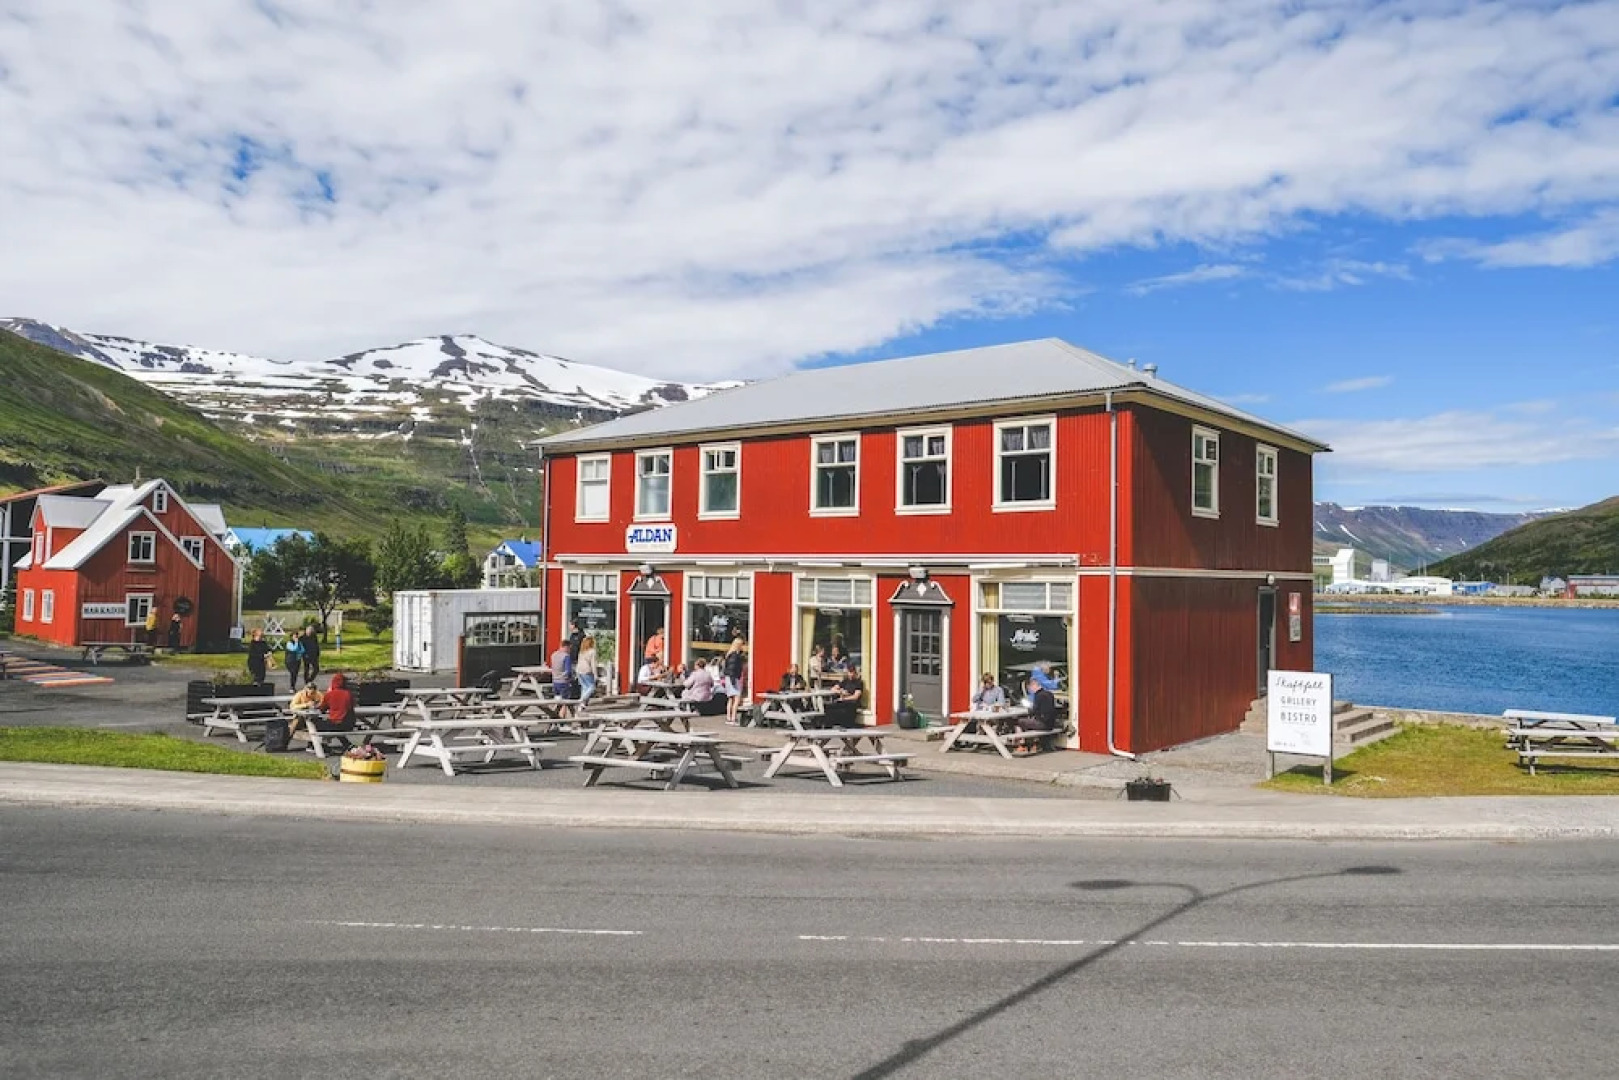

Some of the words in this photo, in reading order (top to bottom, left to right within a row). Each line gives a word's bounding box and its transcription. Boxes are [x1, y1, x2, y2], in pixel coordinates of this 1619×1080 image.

[628, 528, 672, 543] ALDAN
[1281, 695, 1317, 706] GALLERY
[1281, 711, 1317, 723] BISTRO
